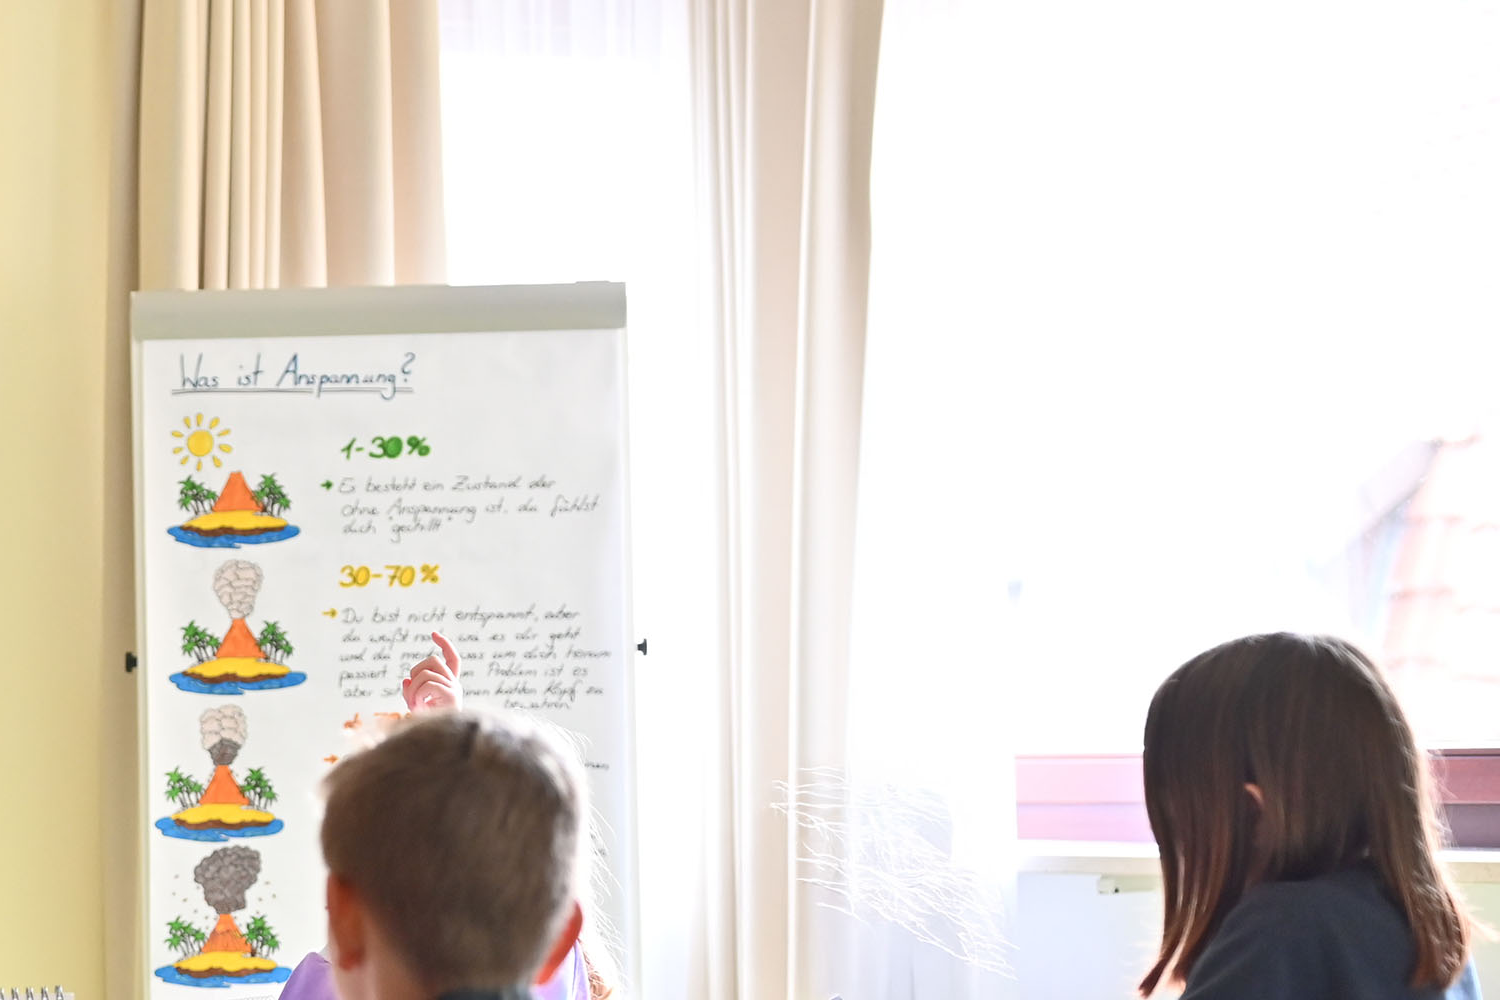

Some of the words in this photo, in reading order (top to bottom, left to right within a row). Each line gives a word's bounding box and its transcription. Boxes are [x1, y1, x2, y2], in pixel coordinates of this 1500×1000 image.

[180, 352, 219, 388] Was
[237, 353, 264, 387] ist
[276, 352, 416, 401] Anspannung?
[372, 606, 400, 623] bist
[407, 606, 447, 622] nicht
